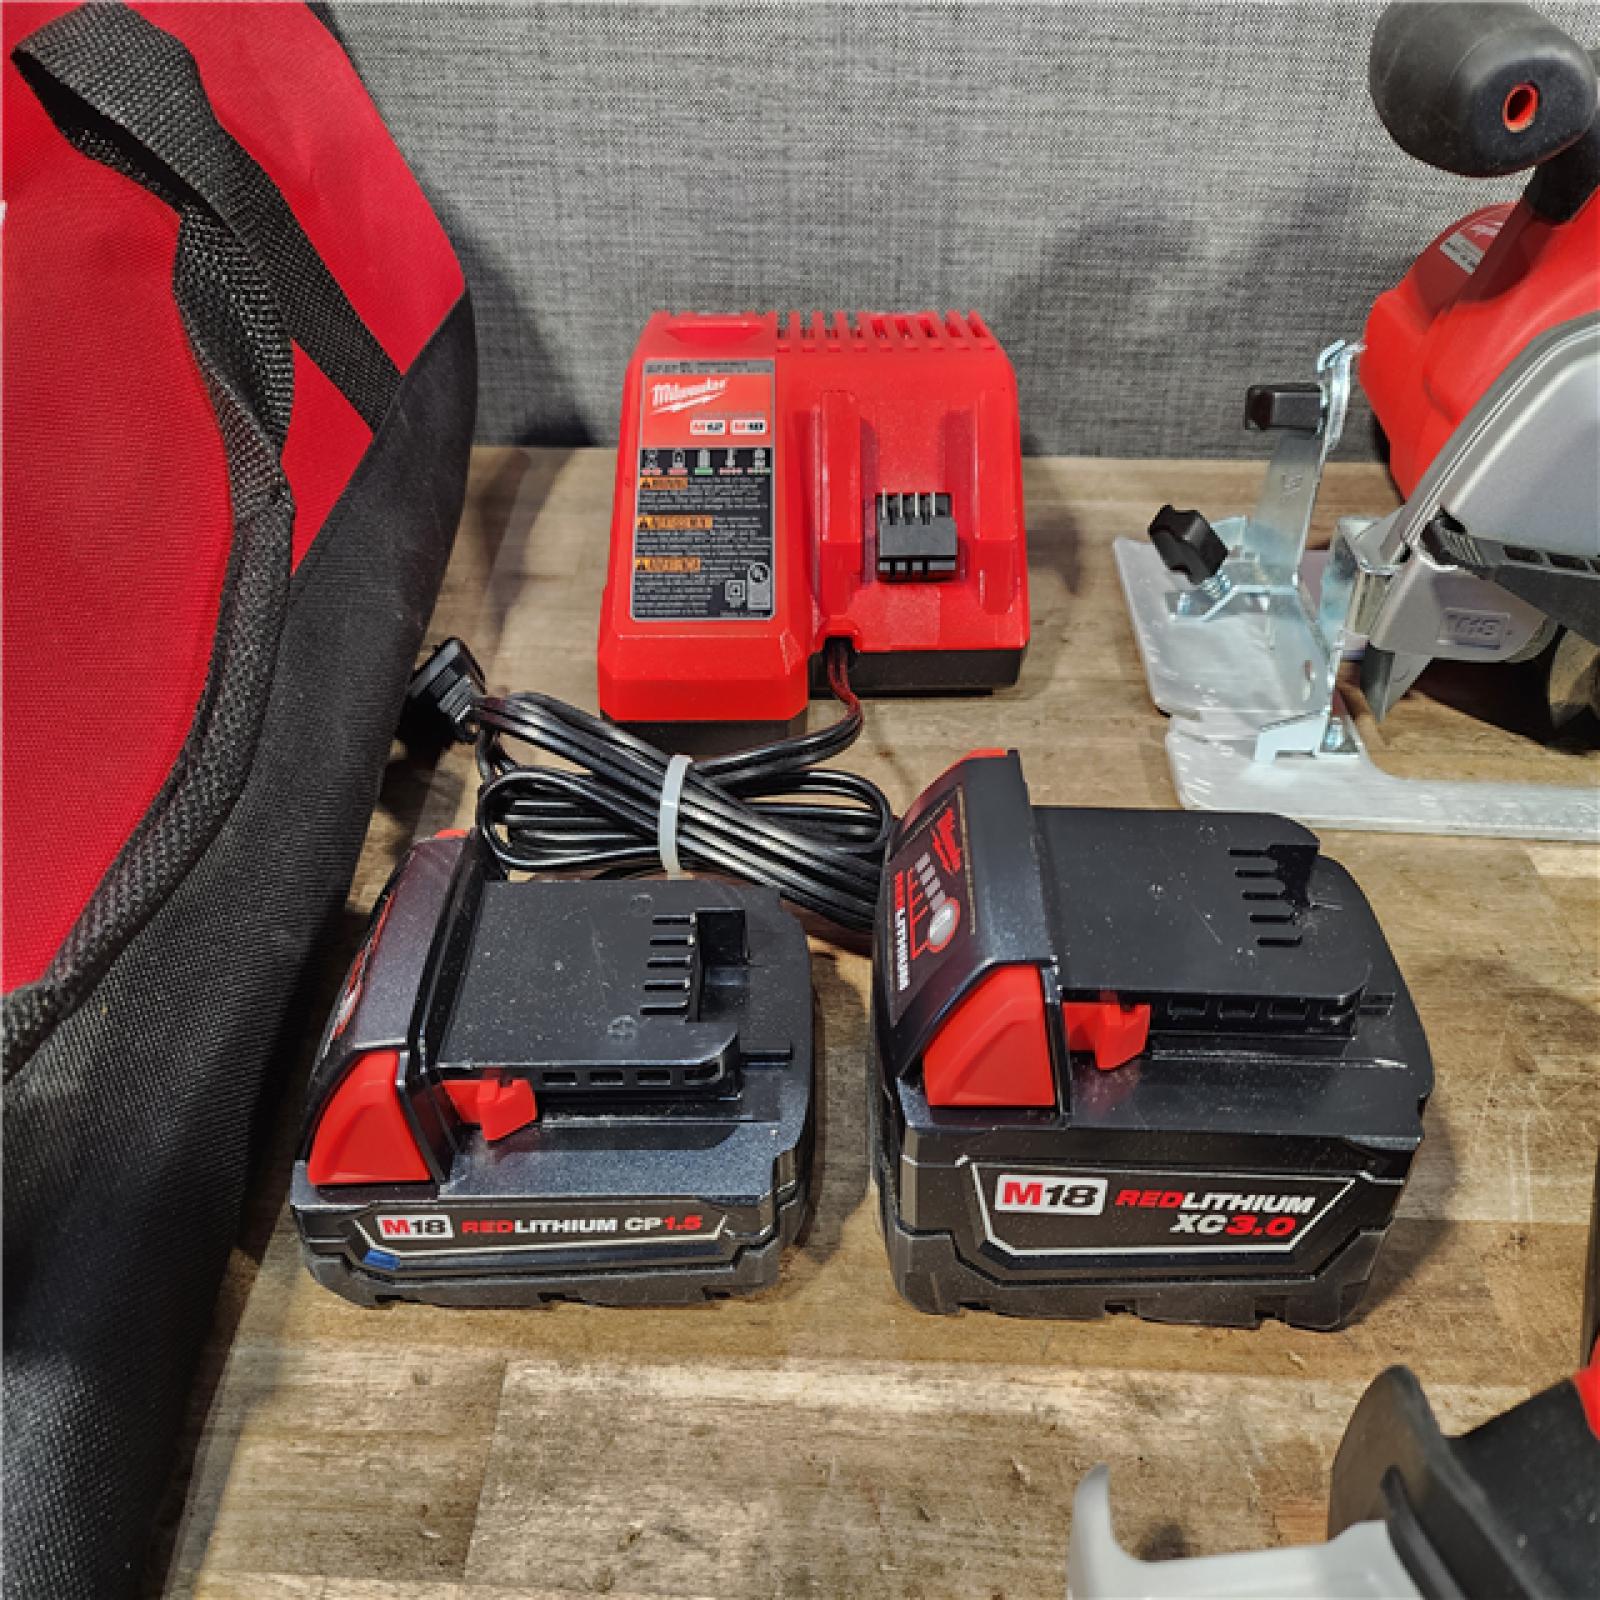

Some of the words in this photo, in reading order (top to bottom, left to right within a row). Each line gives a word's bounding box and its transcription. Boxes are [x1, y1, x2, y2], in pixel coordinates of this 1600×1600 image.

[1004, 1182, 1098, 1207] M18
[1115, 1189, 1316, 1214] REDLITHIUM
[381, 1217, 448, 1236] M18
[461, 1218, 618, 1234] REDLITHIUM
[624, 1215, 703, 1232] CP1.5
[1169, 1214, 1297, 1236] XC3.0
